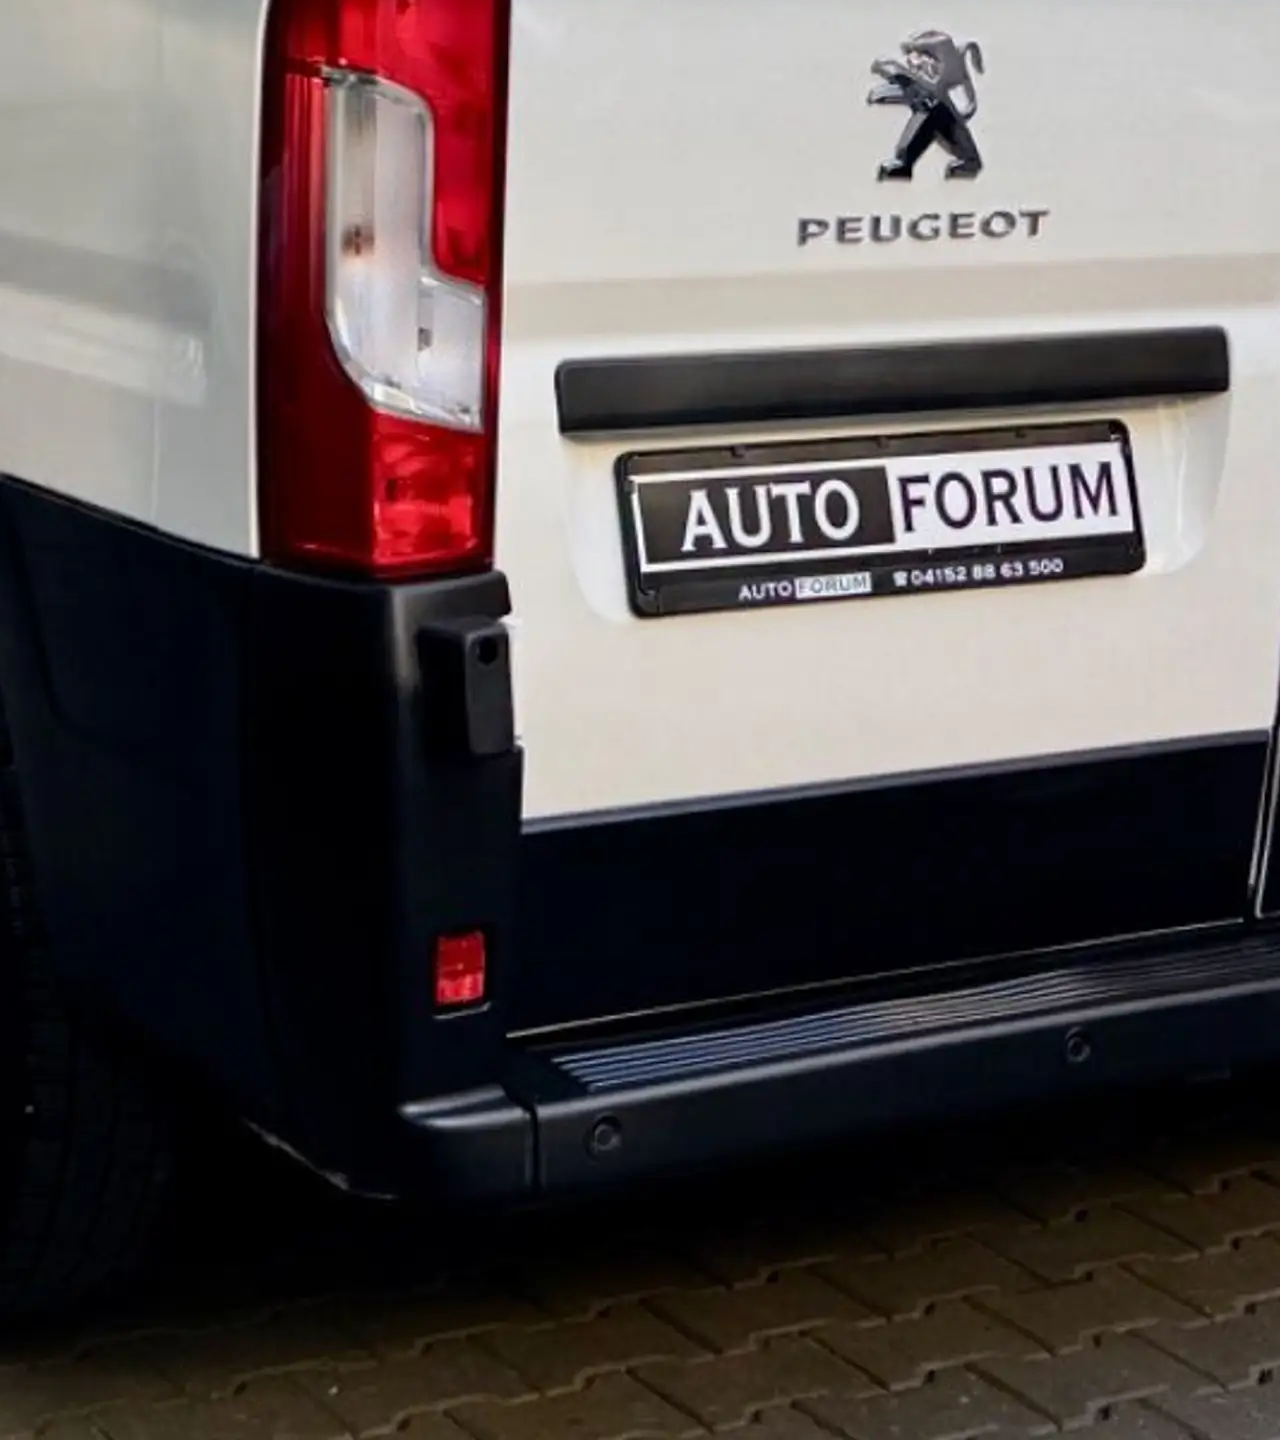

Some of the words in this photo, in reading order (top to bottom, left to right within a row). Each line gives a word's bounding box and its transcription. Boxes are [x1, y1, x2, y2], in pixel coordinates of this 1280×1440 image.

[797, 208, 1051, 247] PEUGEOT
[680, 478, 861, 553] AUTO
[897, 460, 1120, 533] FORUM
[910, 565, 968, 587] 04152
[999, 560, 1024, 578] 63
[1027, 557, 1065, 576] 500
